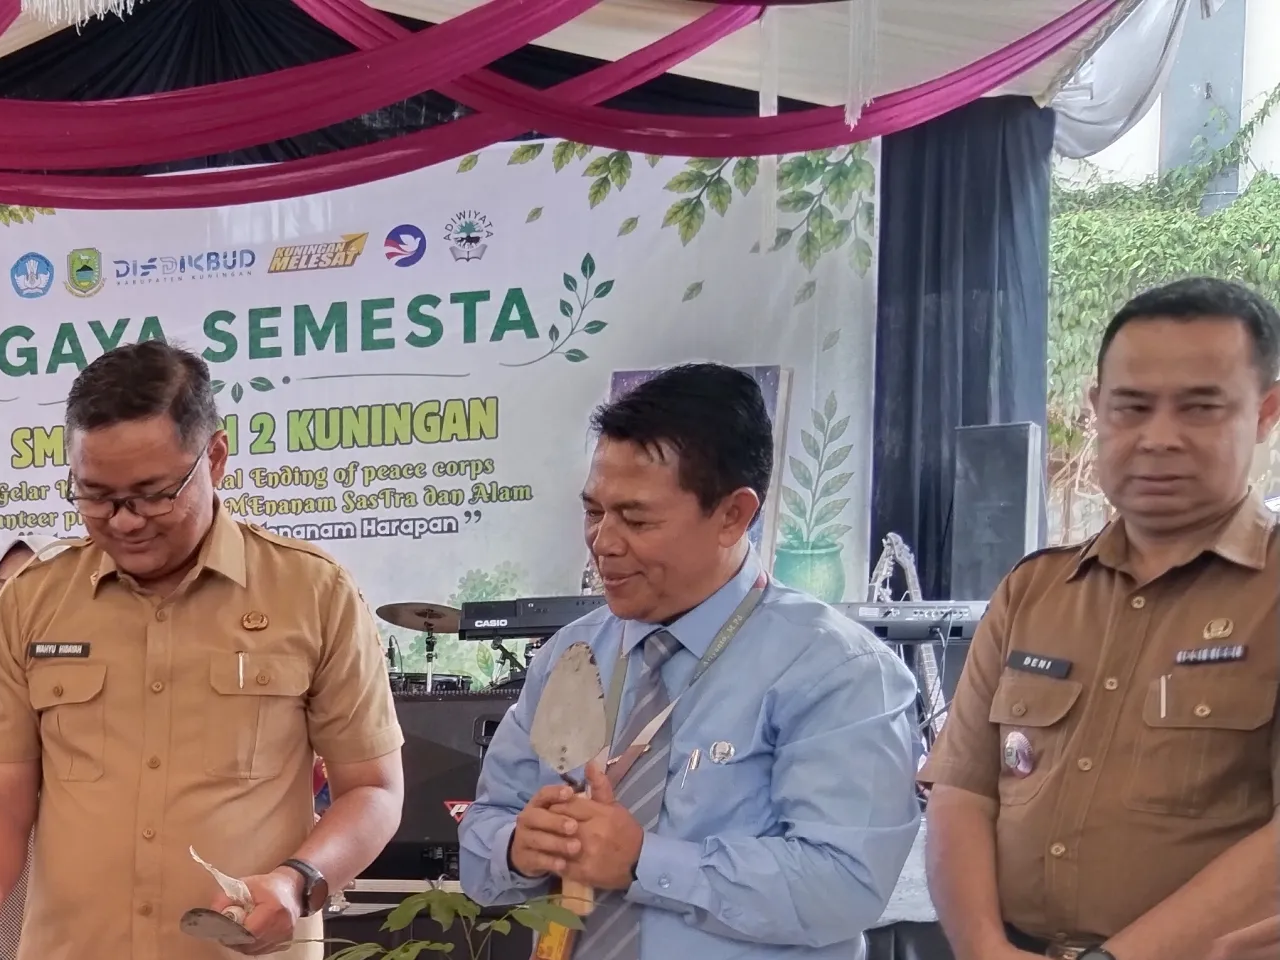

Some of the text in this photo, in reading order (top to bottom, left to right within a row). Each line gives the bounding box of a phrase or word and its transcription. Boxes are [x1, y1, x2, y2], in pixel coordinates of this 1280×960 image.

[443, 209, 494, 241] ADIWIYATA
[269, 251, 359, 272] MELESAT
[274, 242, 346, 257] KUNINGAN
[116, 270, 253, 286] KABUPATEN KUNINGAN
[201, 287, 540, 363] SEMESTA
[11, 425, 70, 469] SM
[249, 411, 276, 455] 2
[287, 396, 499, 452] KUNINGAN
[250, 466, 329, 490] Ending
[333, 460, 360, 487] of
[362, 462, 427, 481] peace
[432, 458, 495, 480] corps
[423, 484, 464, 506] dan
[468, 482, 533, 504] Alam
[265, 520, 357, 541] enanam
[360, 515, 459, 539] Harapan
[474, 619, 508, 628] CASIO
[1023, 656, 1052, 670] DENI
